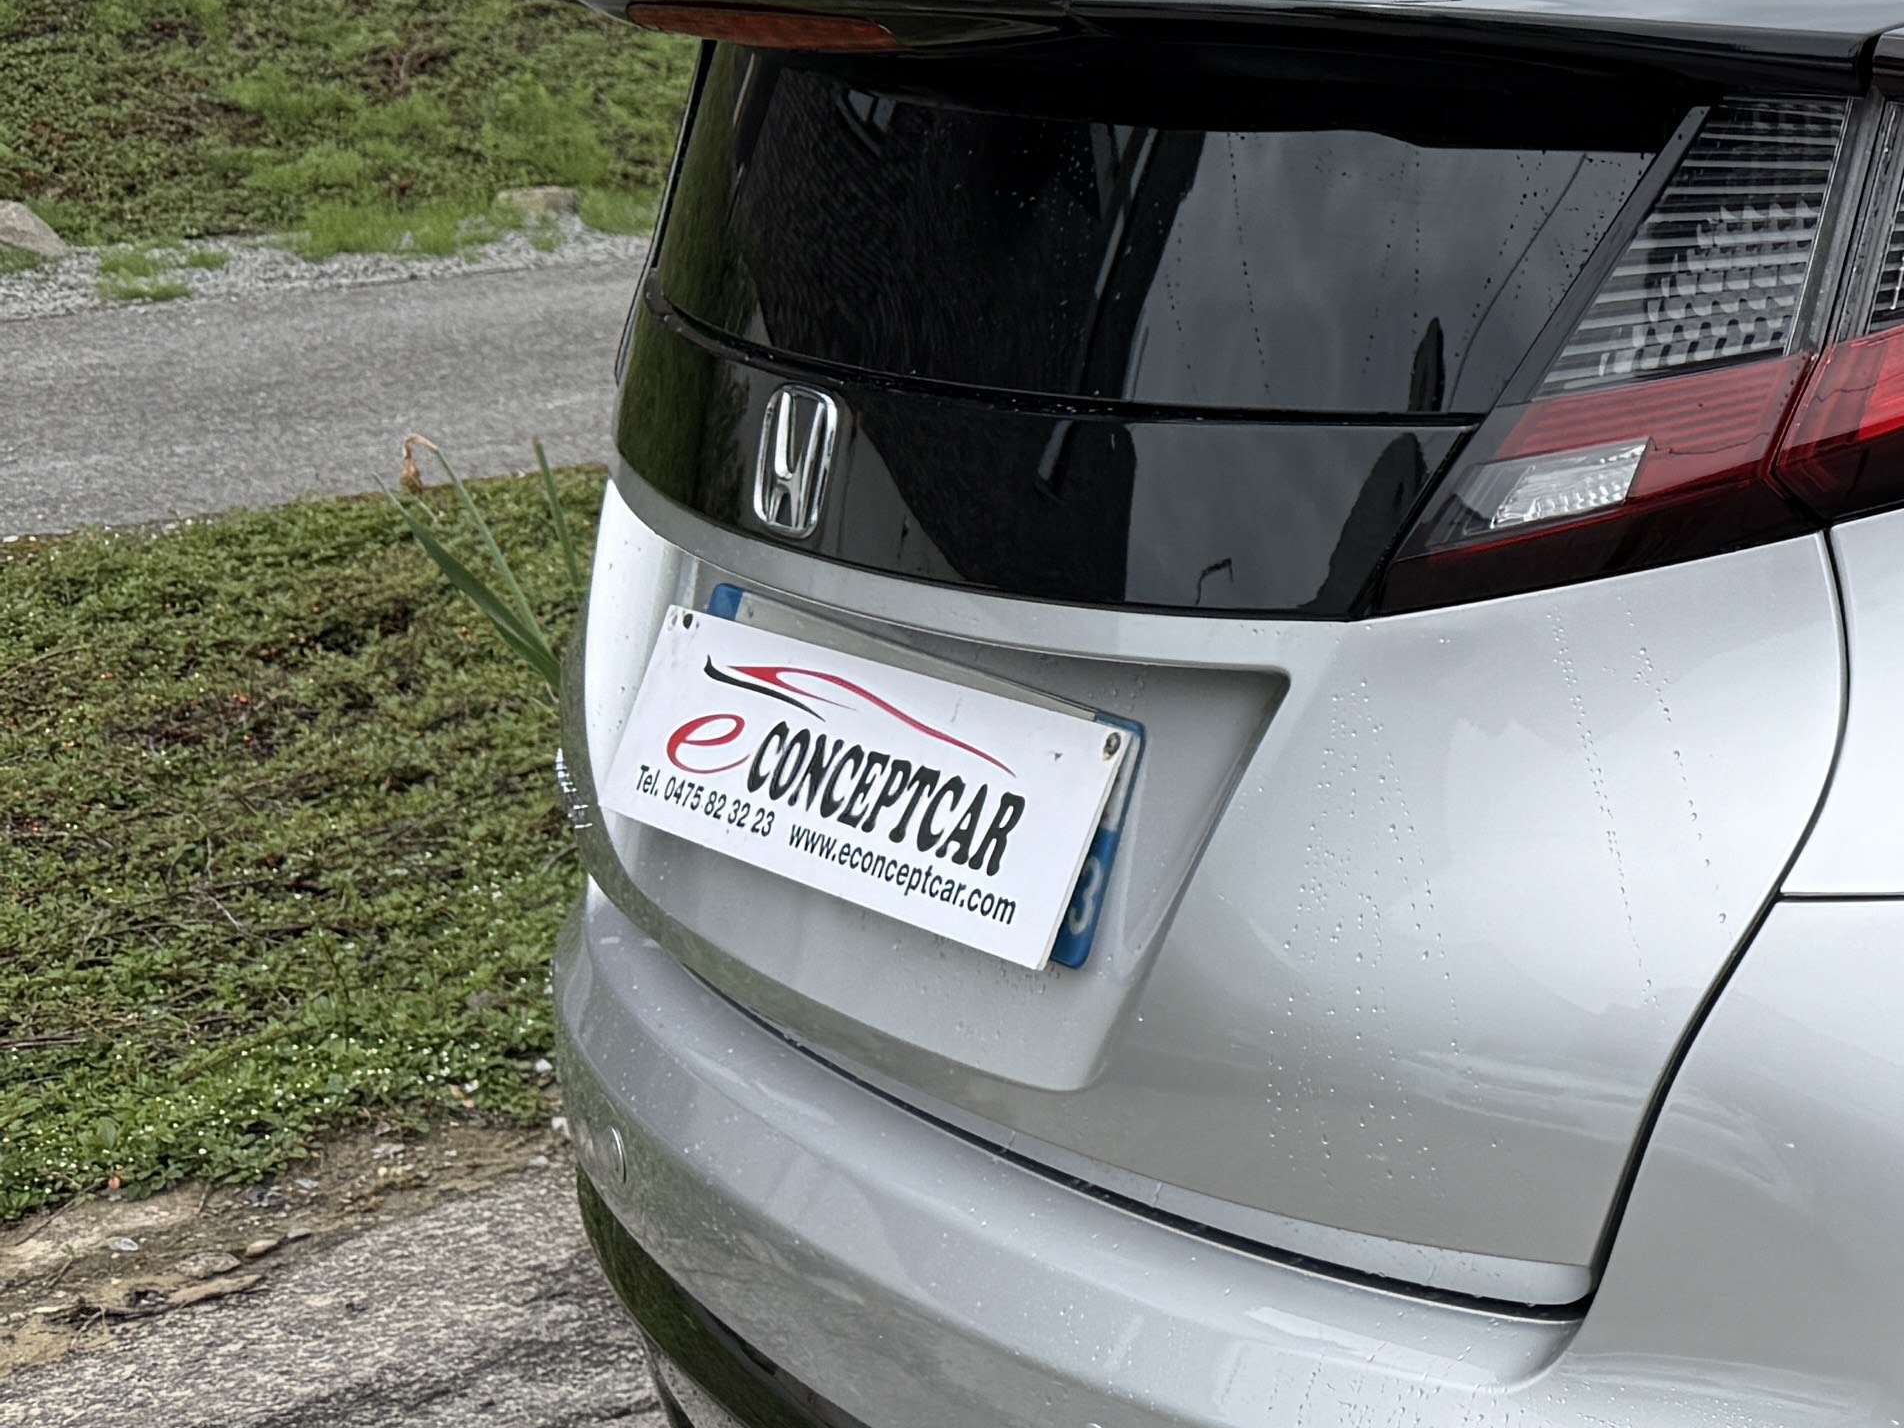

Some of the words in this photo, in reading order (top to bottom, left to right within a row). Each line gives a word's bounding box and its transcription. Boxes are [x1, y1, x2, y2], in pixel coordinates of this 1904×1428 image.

[636, 764, 660, 797] Tel.
[664, 776, 704, 811] 0475
[704, 790, 727, 820] 82
[727, 798, 751, 828] 32
[751, 807, 776, 837] 23
[788, 823, 1018, 925] www.econceptcar.com
